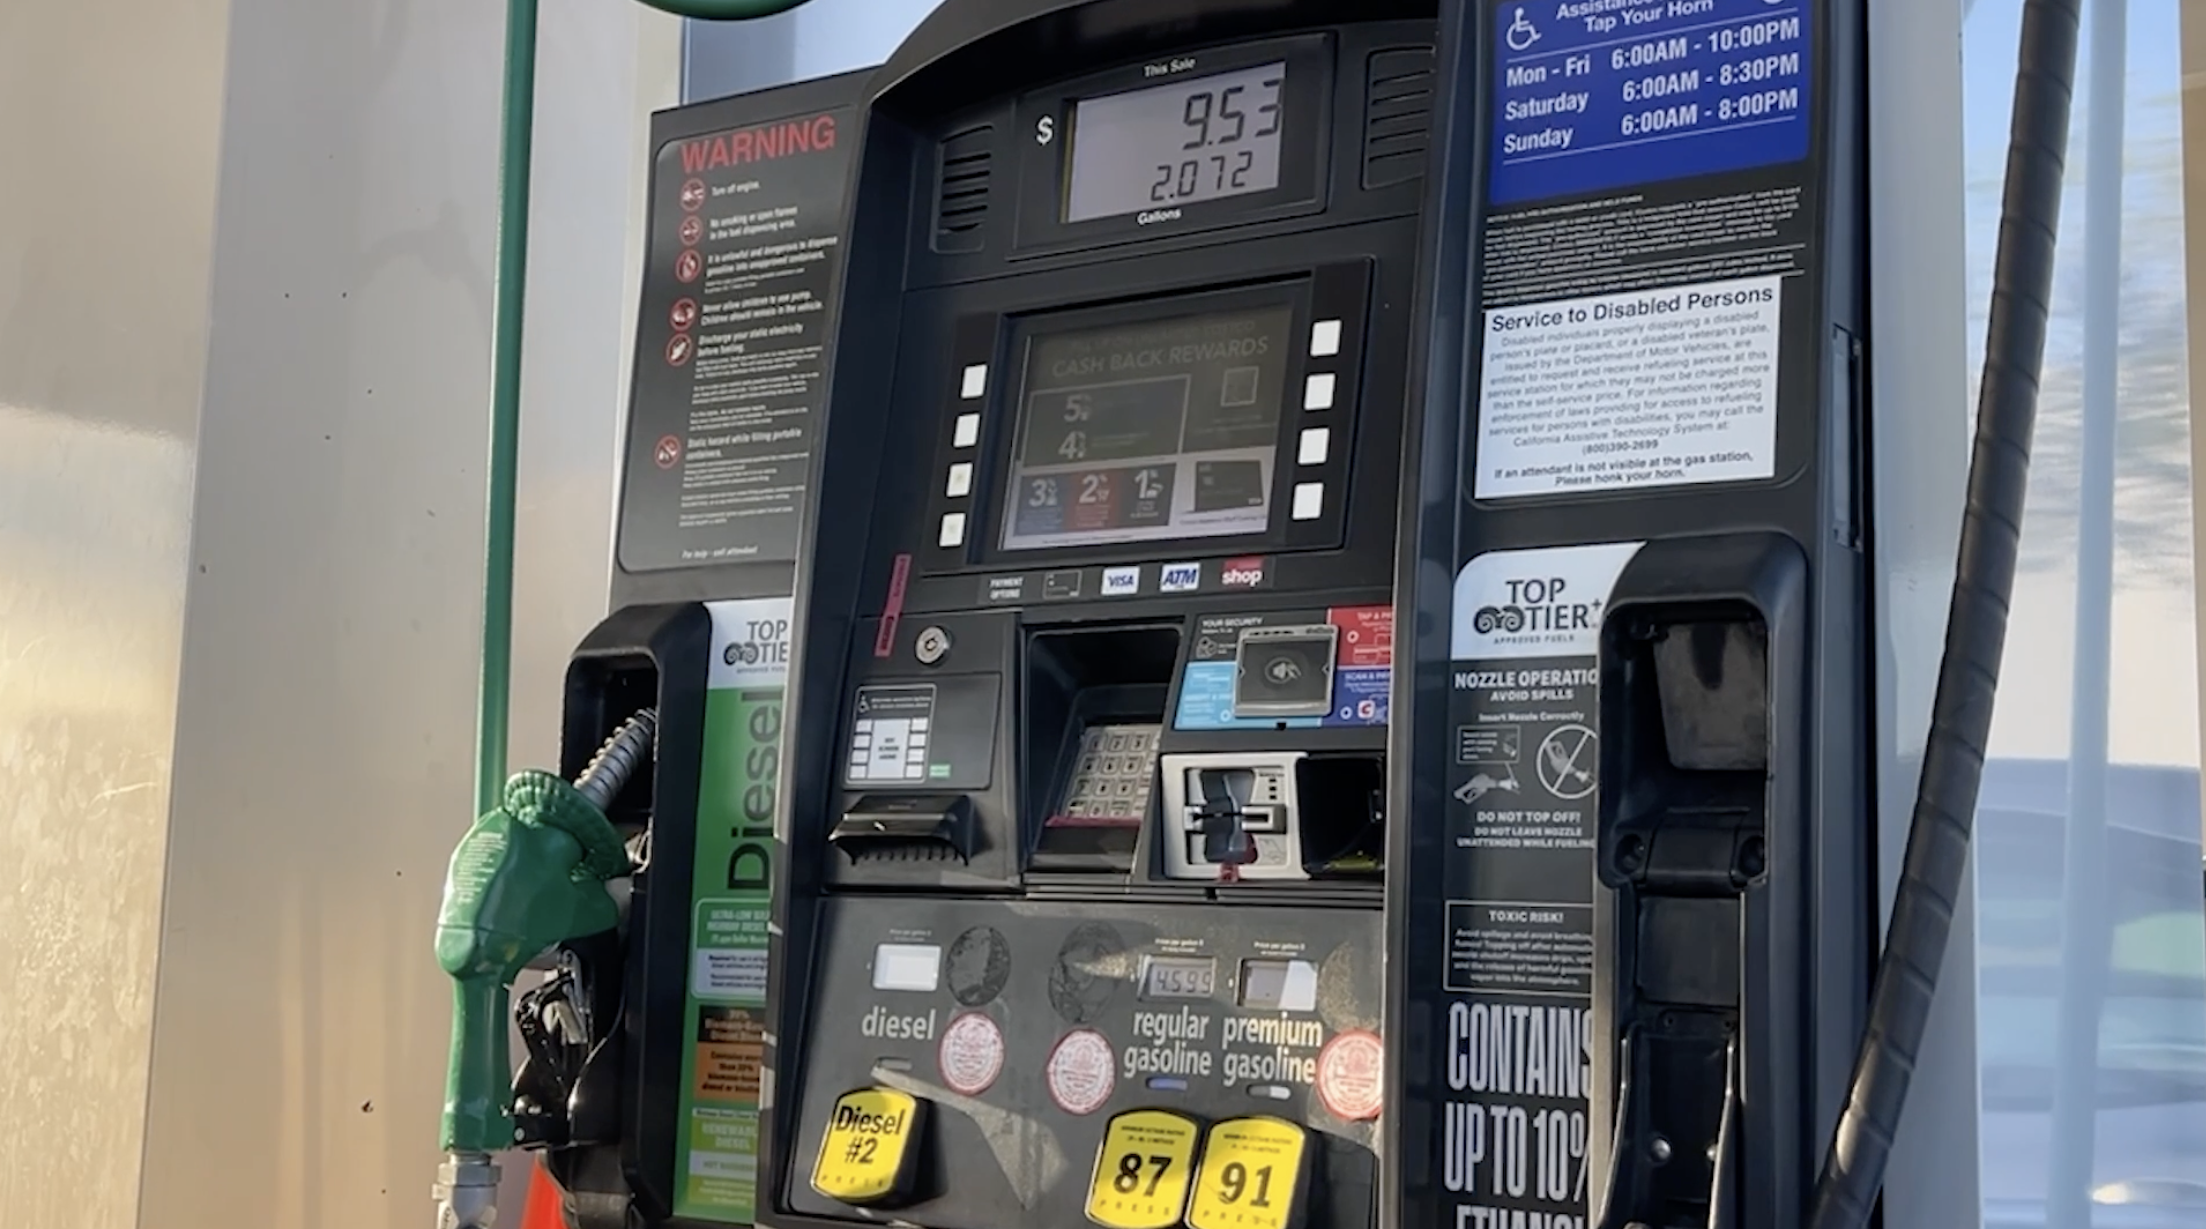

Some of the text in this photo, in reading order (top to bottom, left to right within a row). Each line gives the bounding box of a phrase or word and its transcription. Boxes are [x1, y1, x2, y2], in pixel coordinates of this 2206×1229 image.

[1584, 0, 1714, 33] Tap Your Horn
[1611, 37, 1687, 70] 6:00AM
[1708, 17, 1800, 53] 10:00PM
[1143, 57, 1196, 77] This Sale
[1506, 66, 1547, 87] Mon
[1565, 55, 1590, 77] Fri
[1622, 70, 1699, 102] 6:00AM
[1719, 53, 1799, 85] 8:30PM
[1183, 78, 1282, 150] 9.53
[1505, 91, 1590, 121] Saturday
[1621, 104, 1698, 135] 6:00AM
[1717, 88, 1798, 120] 8:00PM
[680, 113, 837, 174] WARNING
[1036, 115, 1053, 145] $
[1503, 128, 1574, 154] Sunday
[1151, 151, 1253, 201] 2.072
[1137, 208, 1182, 226] Gallons
[1491, 287, 1773, 332] Service to Disabled Persons
[1052, 356, 1105, 378] CASH
[1110, 349, 1163, 371] BACK
[1168, 336, 1269, 364] REWARDS
[1494, 468, 1503, 479] If
[1505, 469, 1518, 478] an
[1521, 463, 1573, 477] attendant
[1575, 462, 1585, 473] is
[1587, 461, 1606, 472] not
[1609, 458, 1647, 469] visible
[1649, 457, 1659, 467] at
[1662, 455, 1682, 465] the
[1685, 455, 1706, 467] gas
[1555, 475, 1592, 486] Please
[1595, 472, 1623, 483] honk
[1626, 470, 1653, 483] your
[990, 577, 1024, 588] PAYMENT
[1107, 575, 1134, 587] VISA
[1162, 569, 1198, 586] ATM
[1221, 568, 1262, 588] shop
[1505, 577, 1567, 604] TOP
[746, 619, 788, 641] TOP
[1202, 616, 1264, 628] YOUR SECURITY
[759, 641, 788, 663] TIE
[1493, 634, 1575, 645] APPROVED FUELS
[1454, 668, 1598, 689] NOZZLE OPERATIO
[1489, 688, 1575, 702] AVOID SPILLS
[1478, 711, 1585, 722] Insert Nozzle Correctly
[727, 690, 785, 890] Diesel
[1476, 811, 1496, 822] DO
[1497, 811, 1523, 822] NOT
[1525, 811, 1551, 822] TOP
[1456, 837, 1522, 847] UNATTENDED
[1523, 838, 1553, 847] WHILE
[1474, 827, 1582, 836] DO NOT LEAVE NOZZLE
[1489, 910, 1528, 922] TOXIC
[861, 1005, 936, 1040] diesel
[1133, 1005, 1210, 1046] regular
[1222, 1011, 1323, 1050] premium
[1124, 1040, 1212, 1078] gasoline
[1223, 1046, 1316, 1086] gasoline
[835, 1105, 906, 1135] Diesel
[845, 1137, 878, 1163] #2
[1444, 1102, 1486, 1192] UP
[1490, 1104, 1528, 1197] TO
[1113, 1153, 1173, 1197] 87
[1218, 1162, 1274, 1209] 91
